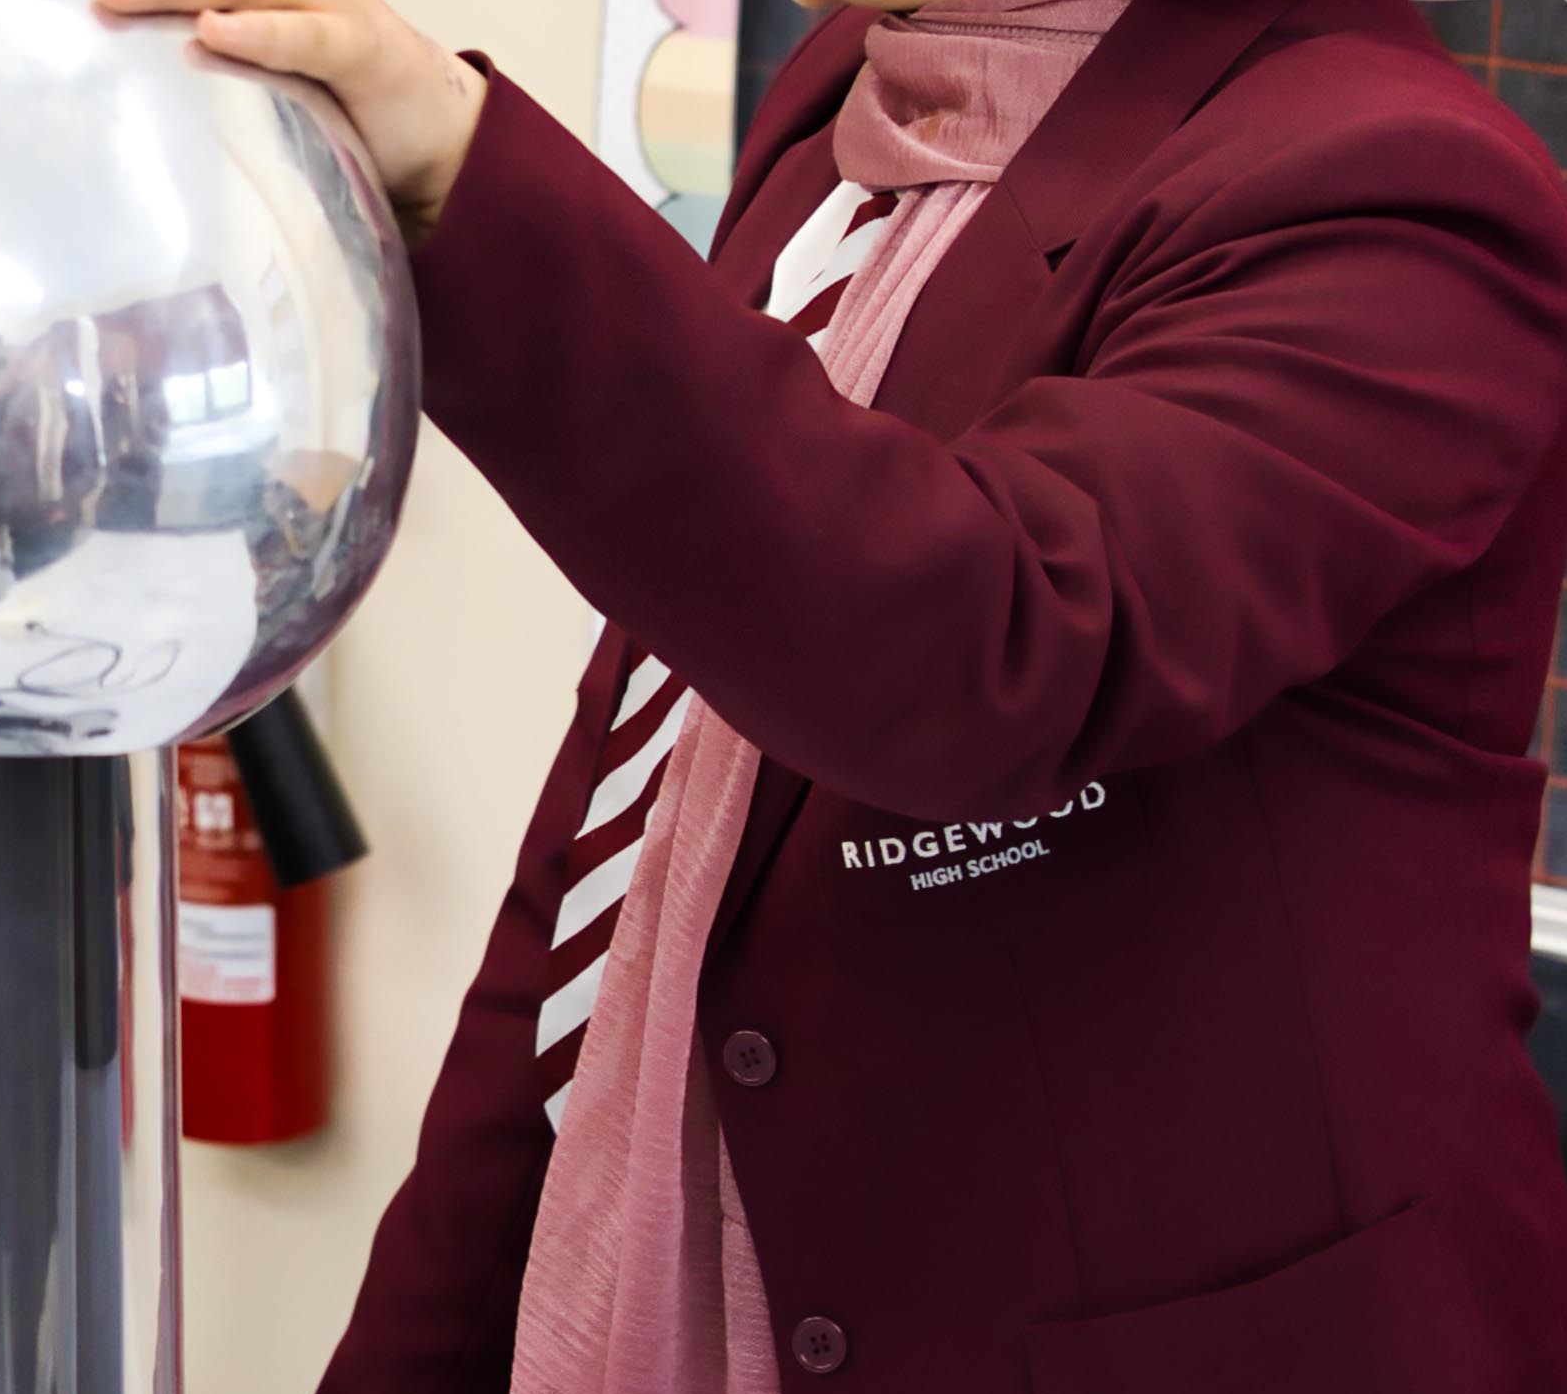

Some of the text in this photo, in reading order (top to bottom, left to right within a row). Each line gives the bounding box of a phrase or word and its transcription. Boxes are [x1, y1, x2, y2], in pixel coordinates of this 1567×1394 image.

[841, 780, 1107, 870] RIDGEWD
[909, 838, 1050, 891] HIGH SCHOOL
